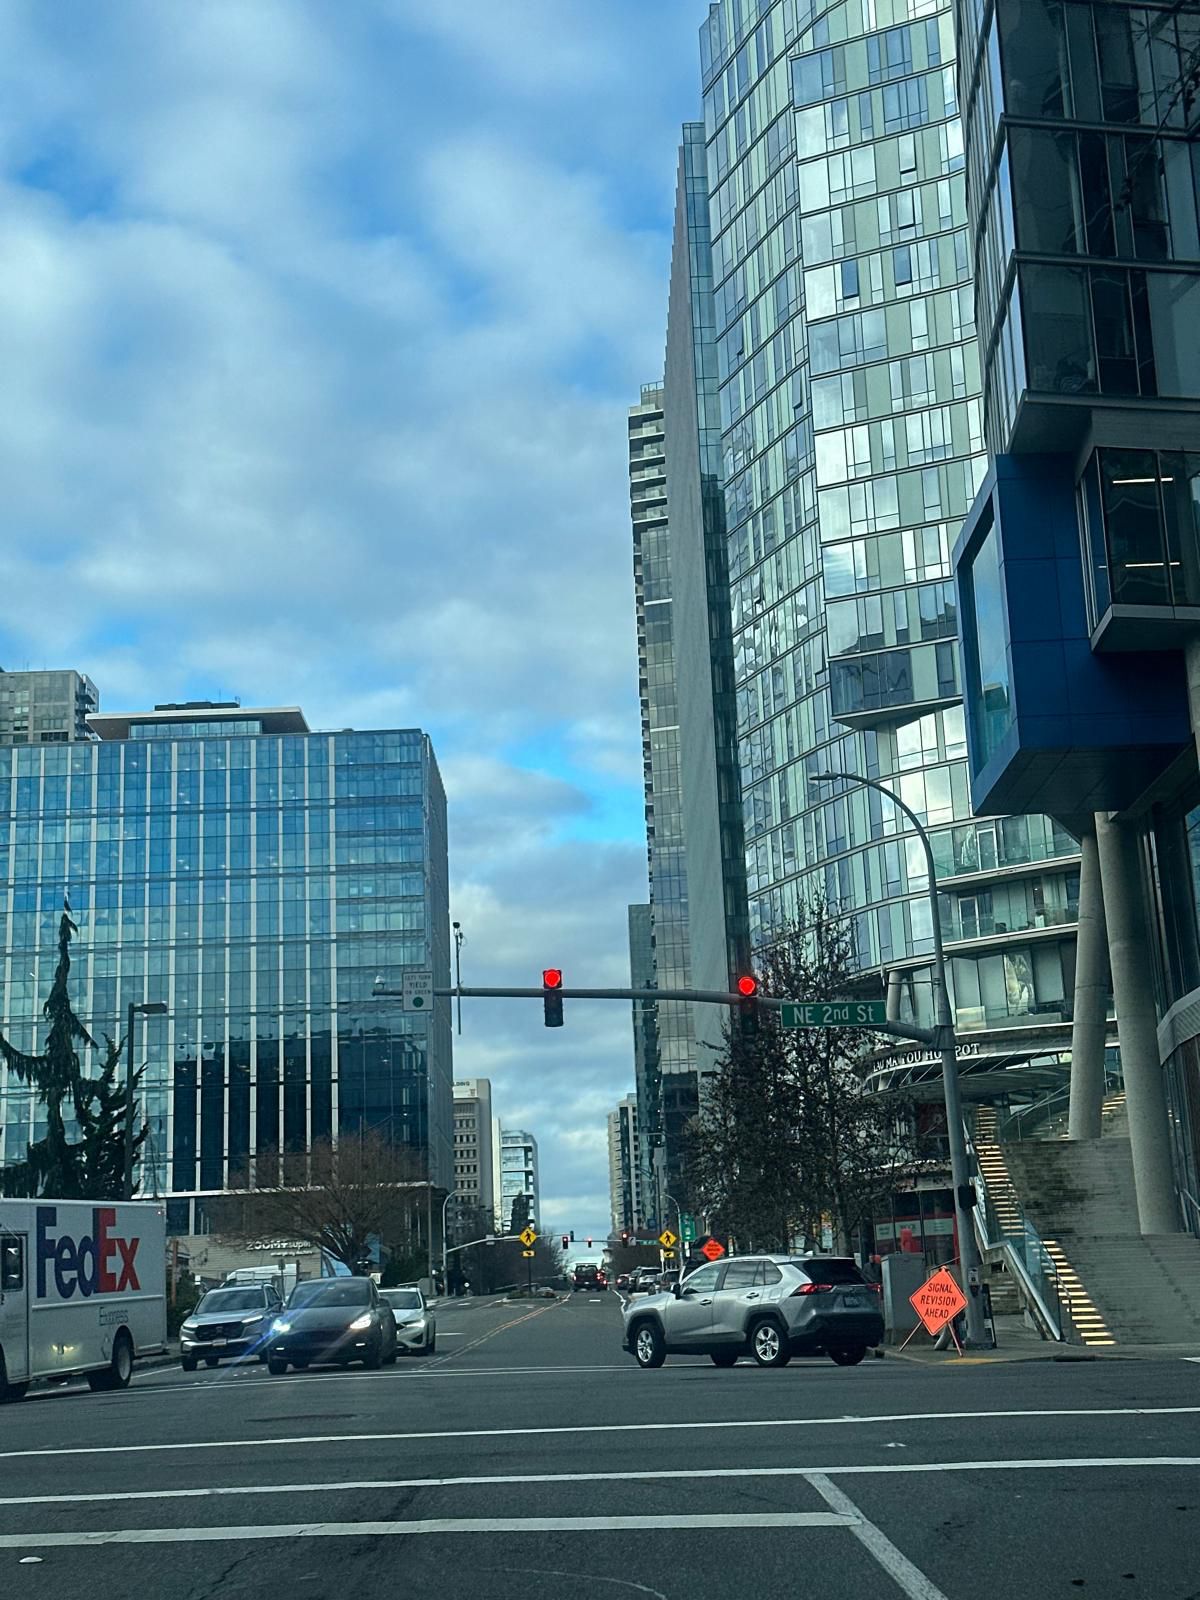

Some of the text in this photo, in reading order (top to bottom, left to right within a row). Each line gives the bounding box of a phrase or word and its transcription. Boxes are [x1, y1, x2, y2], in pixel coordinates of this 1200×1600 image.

[793, 1004, 874, 1024] NE 2nd St
[36, 1206, 141, 1298] FedEx
[927, 1282, 953, 1294] SIGNAL
[920, 1294, 957, 1306] REVISION
[924, 1308, 949, 1319] AHEAD
